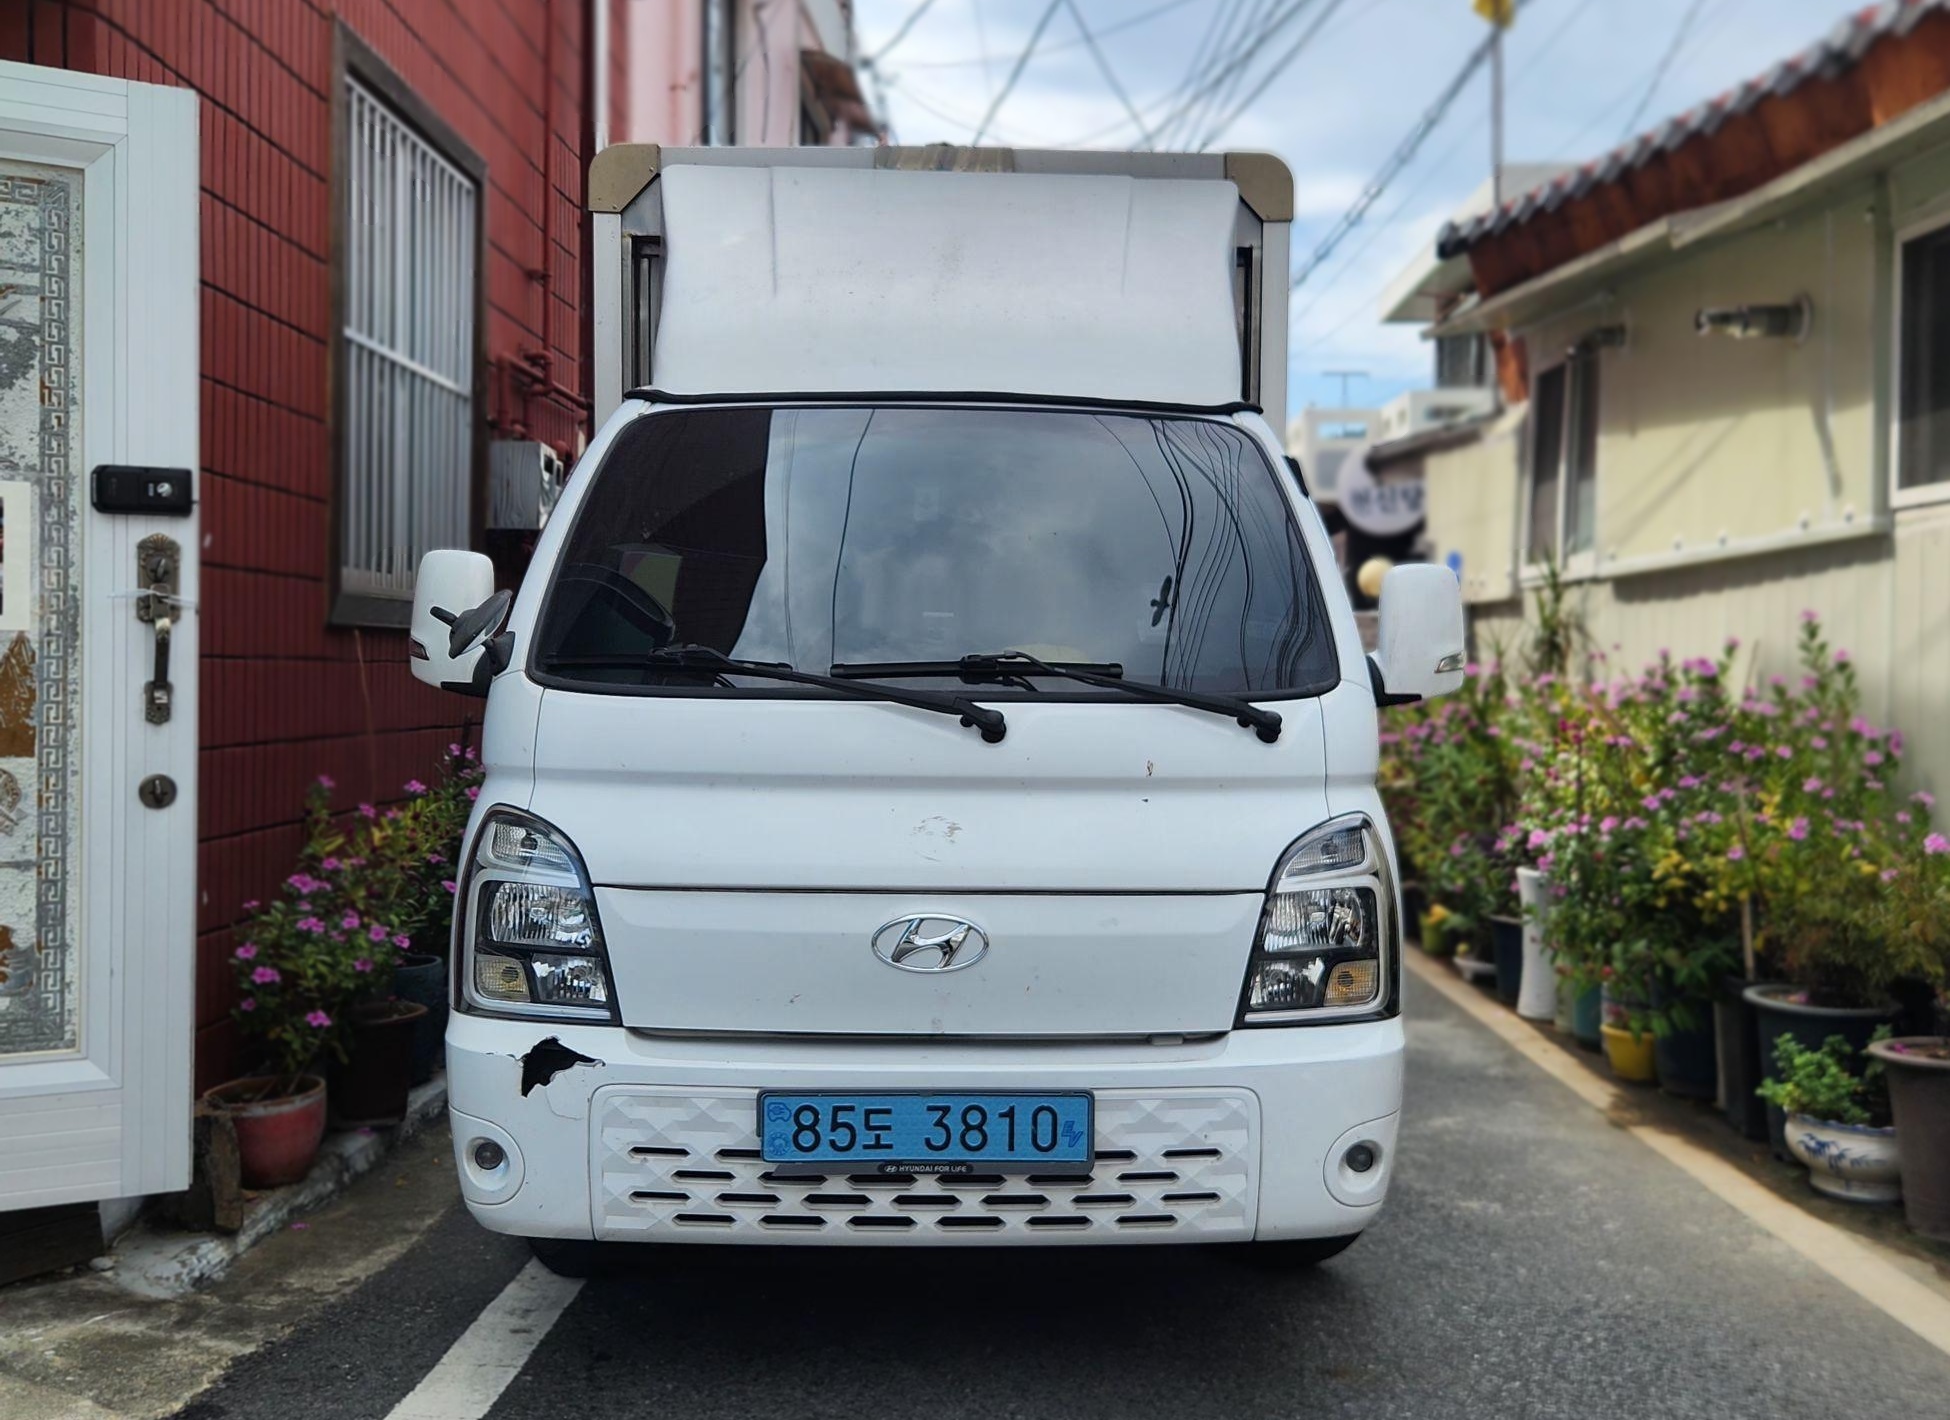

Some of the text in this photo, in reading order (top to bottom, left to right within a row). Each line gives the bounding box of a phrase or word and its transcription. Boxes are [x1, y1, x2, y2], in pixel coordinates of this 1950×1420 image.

[792, 1104, 1058, 1152] 85도 3810
[1061, 1120, 1084, 1148] EV
